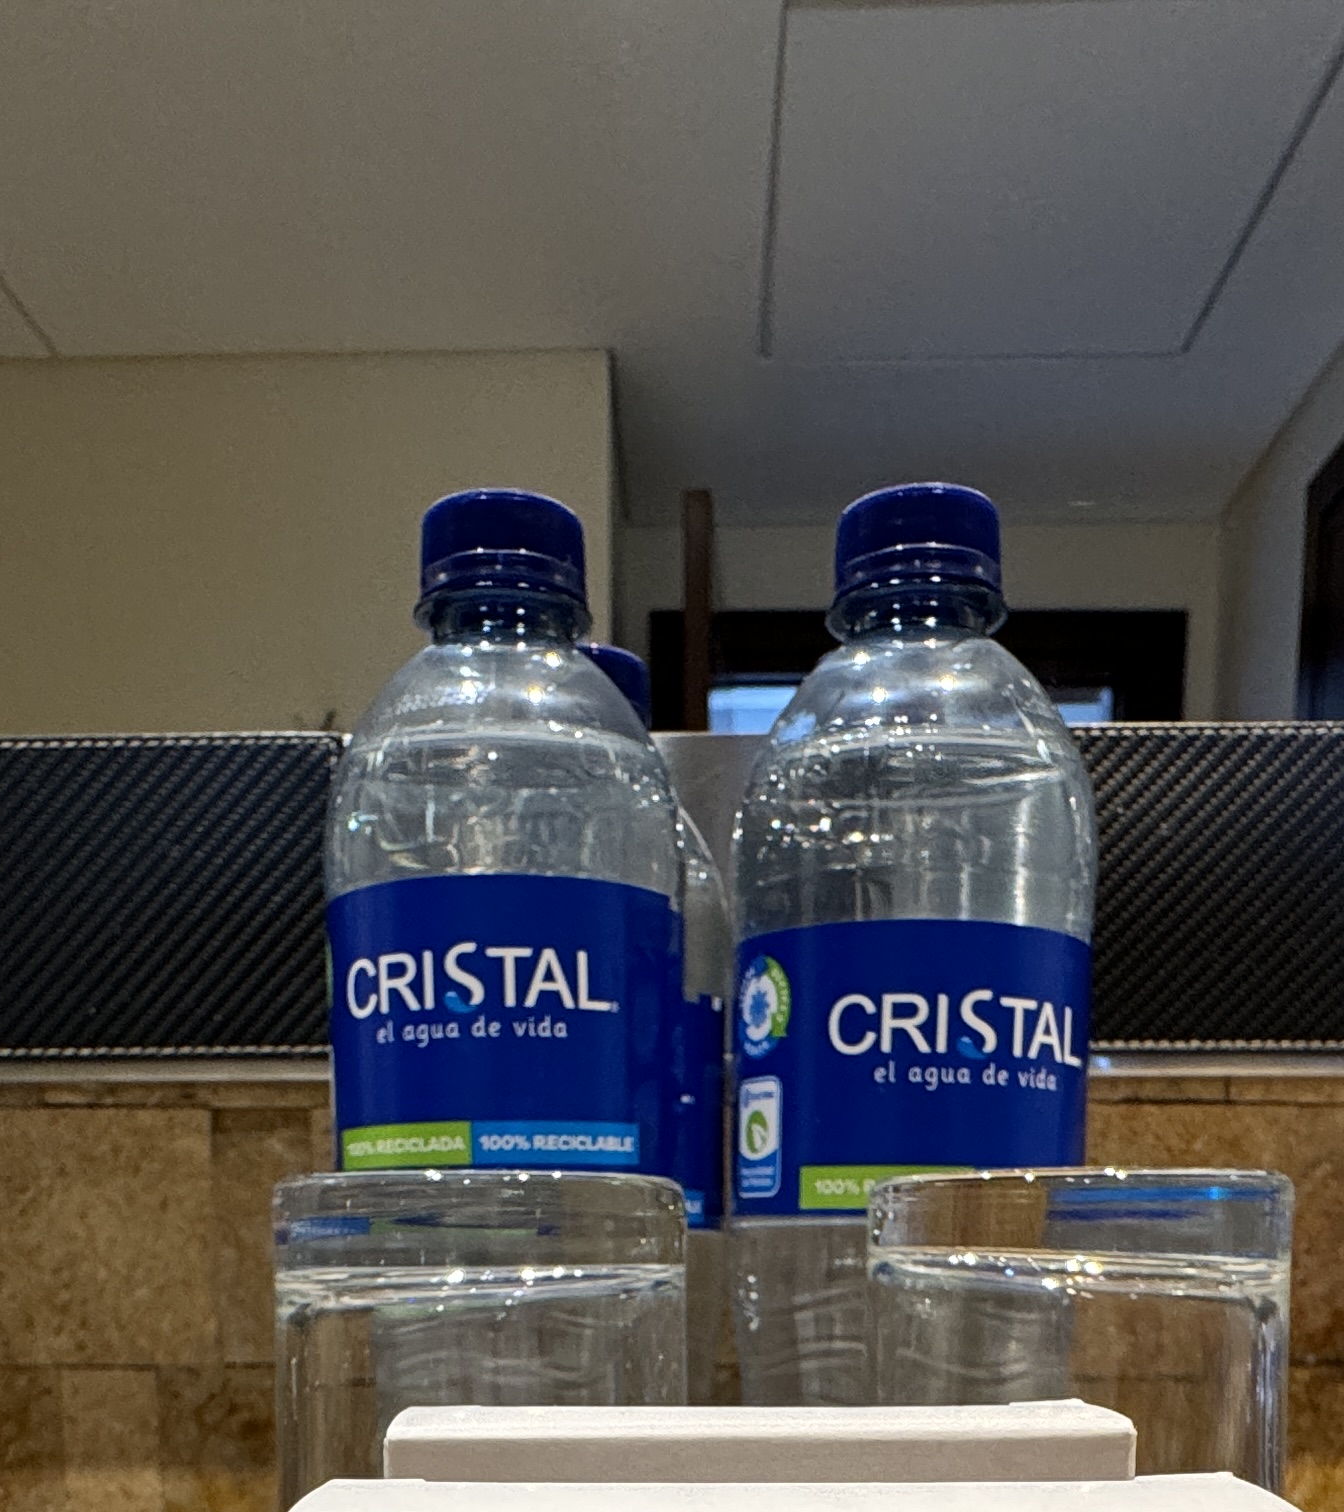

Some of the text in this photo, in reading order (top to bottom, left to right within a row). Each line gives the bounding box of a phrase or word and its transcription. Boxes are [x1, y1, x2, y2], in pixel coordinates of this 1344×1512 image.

[346, 941, 613, 1019] CRISTAL
[376, 1014, 568, 1048] el agua de vida
[828, 989, 1084, 1067] CRISTAL
[873, 1060, 1057, 1092] el agua de vida
[478, 1134, 635, 1152] 100% RECICLABLE
[815, 1179, 860, 1195] 100%
